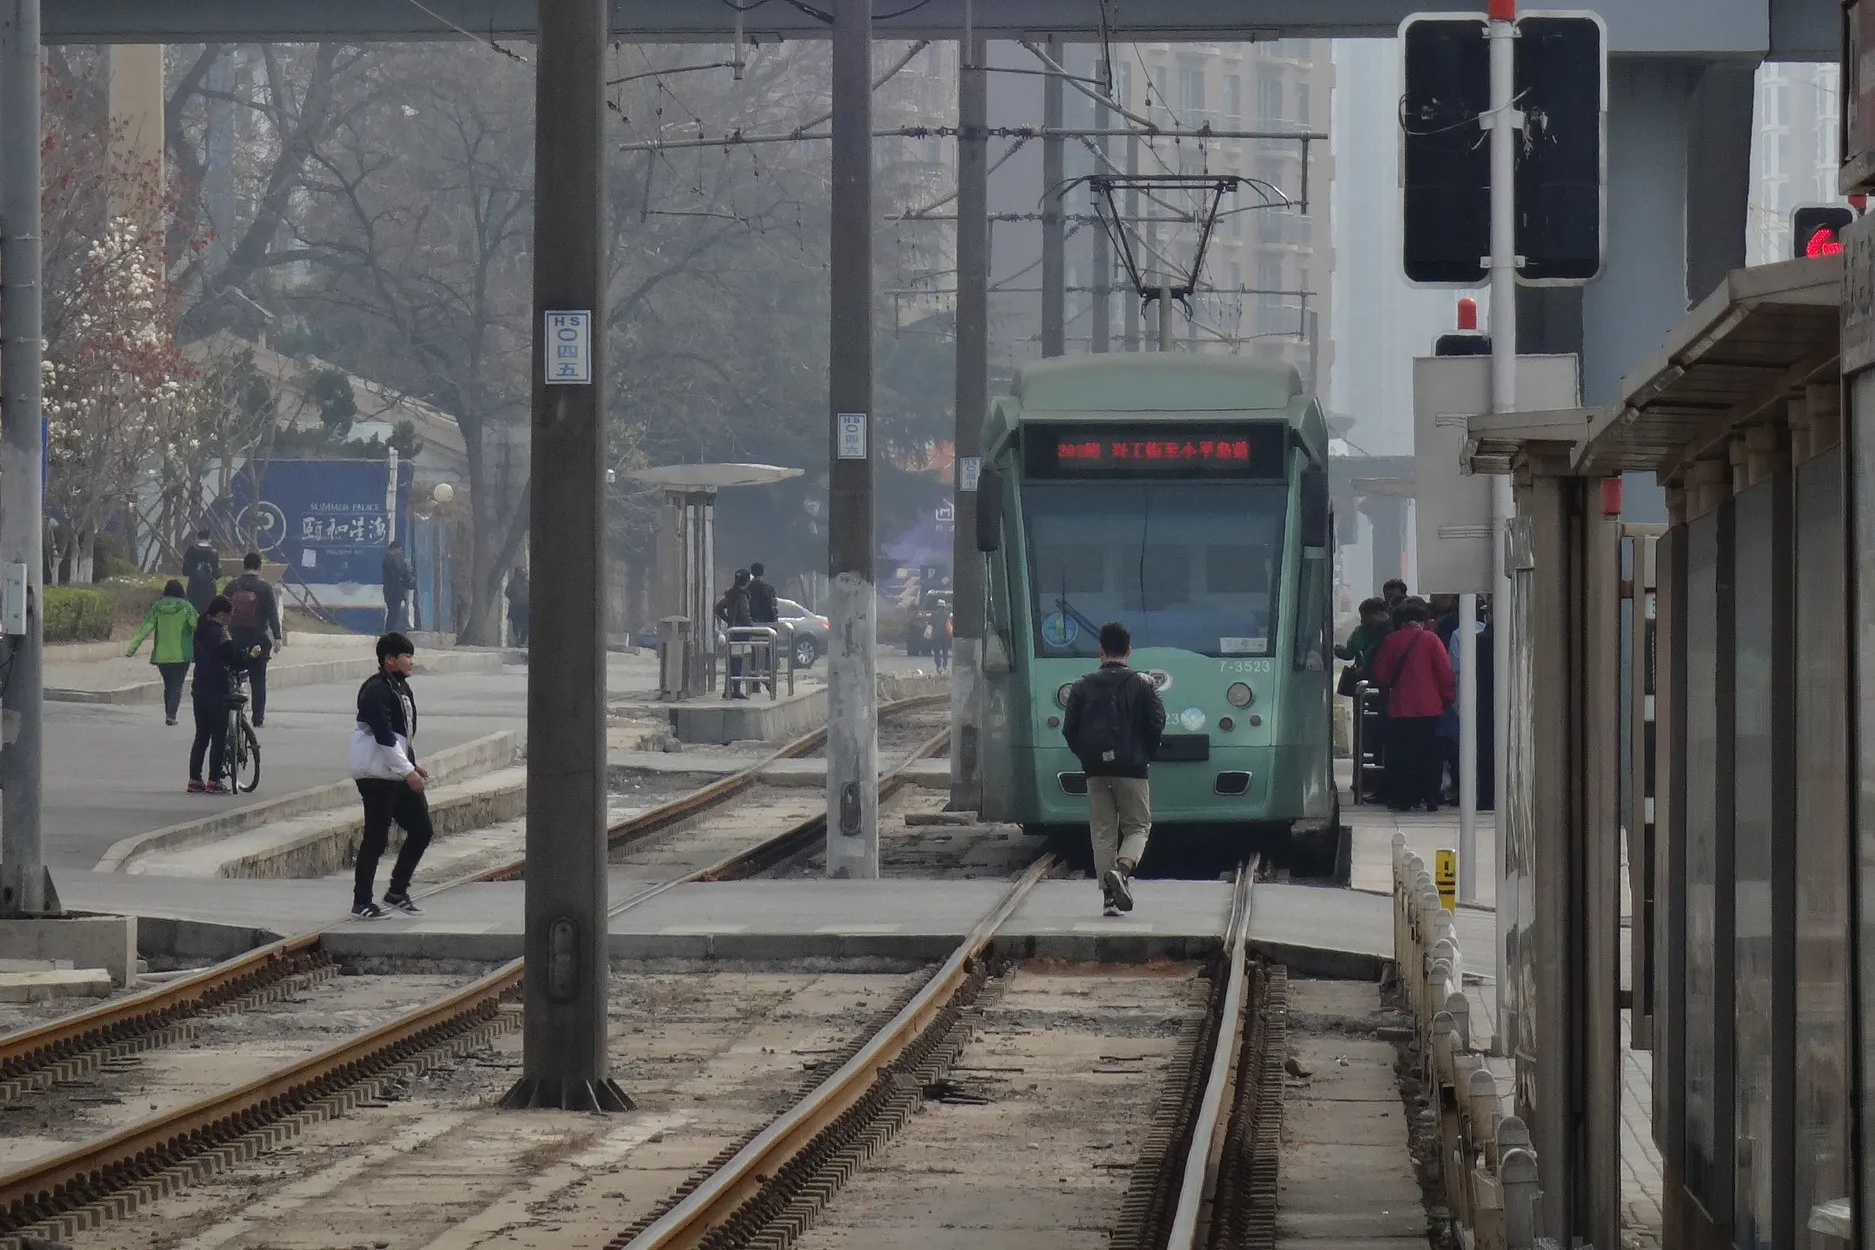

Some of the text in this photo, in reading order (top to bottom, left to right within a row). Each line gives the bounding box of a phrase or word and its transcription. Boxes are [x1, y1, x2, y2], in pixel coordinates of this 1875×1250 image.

[555, 317, 580, 326] HS
[310, 502, 381, 511] SUMMER PALACE
[1220, 661, 1270, 672] 7-3523
